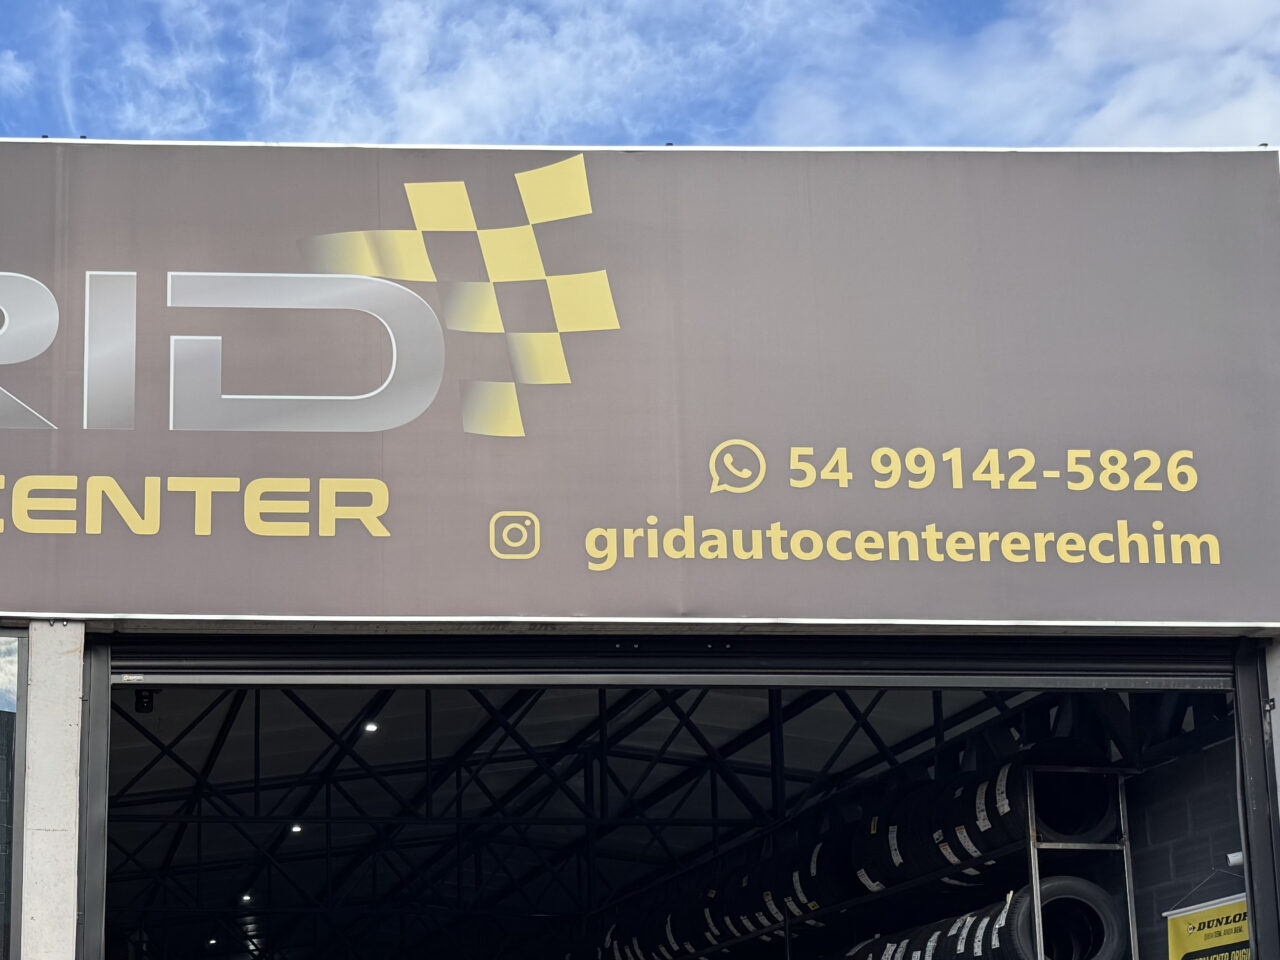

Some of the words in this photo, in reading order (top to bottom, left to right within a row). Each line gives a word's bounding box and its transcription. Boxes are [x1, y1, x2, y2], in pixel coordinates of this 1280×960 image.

[790, 446, 853, 488] 54
[871, 446, 1198, 492] 99142-5826
[585, 515, 1221, 571] gridautocentererechim
